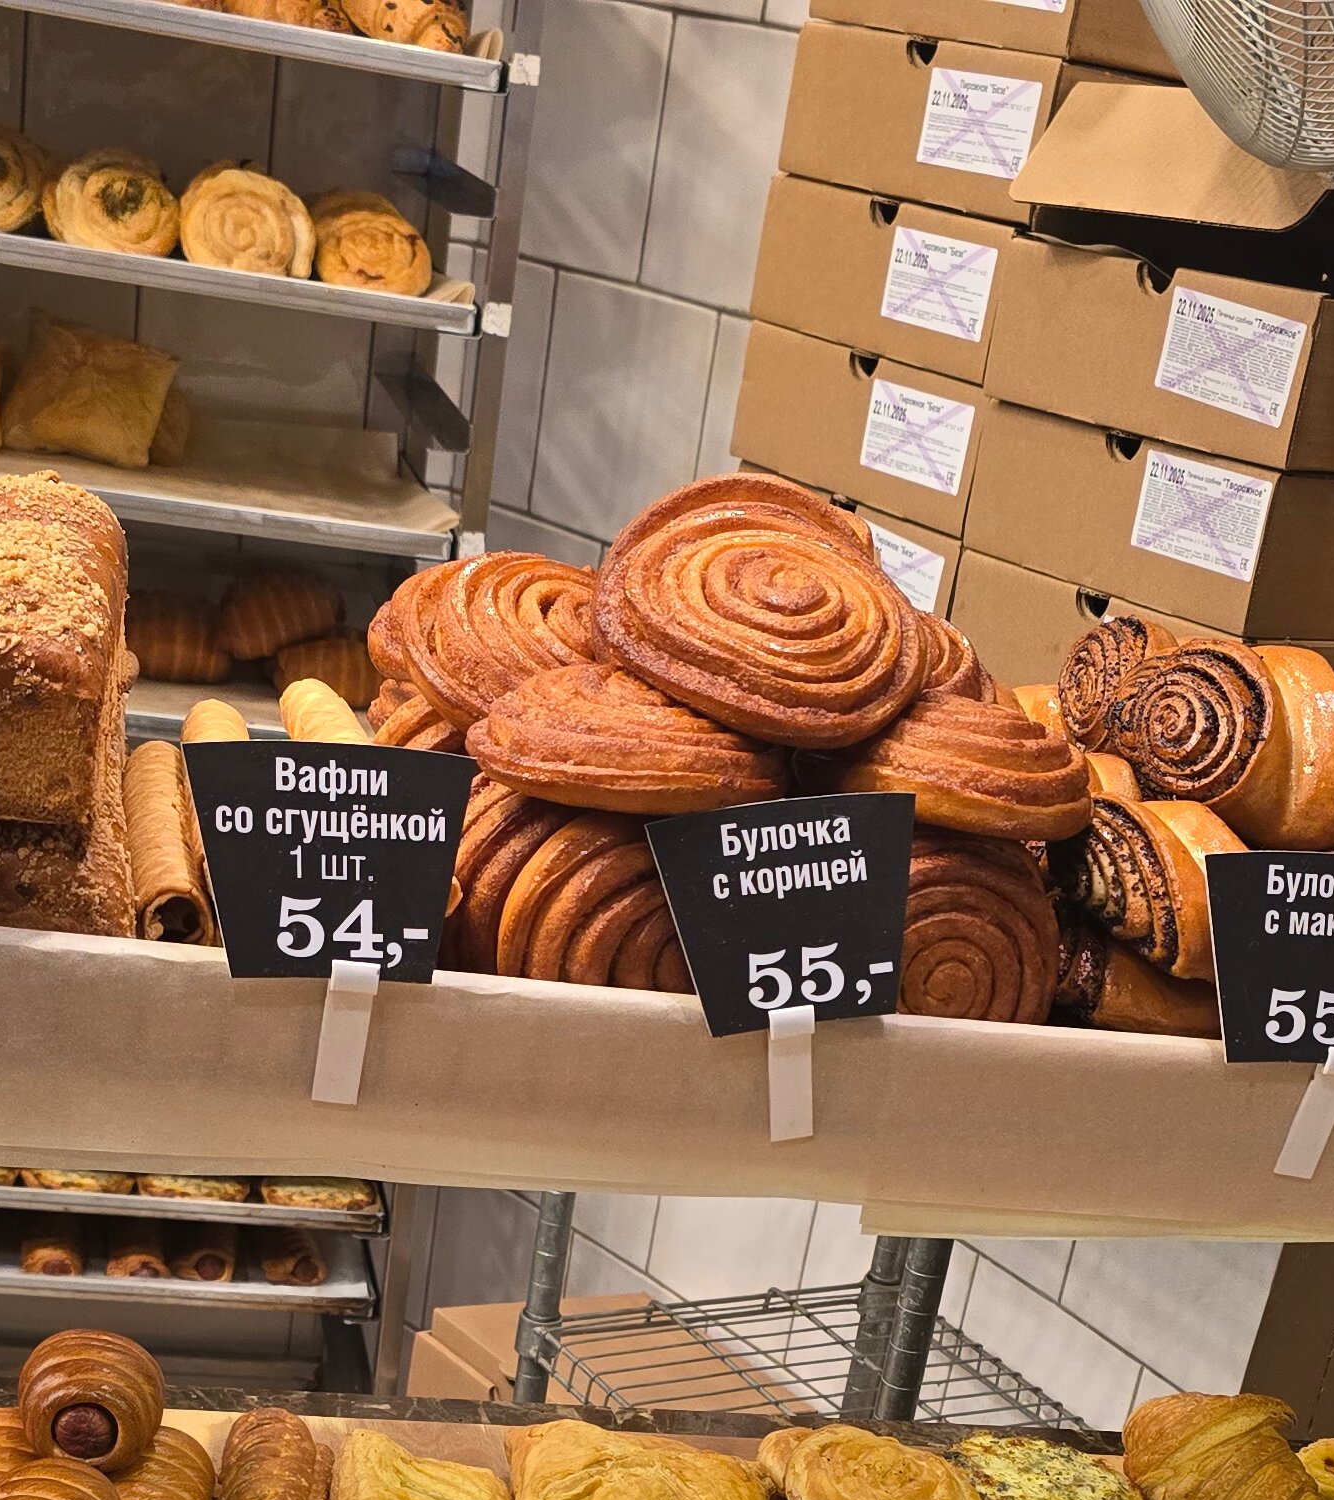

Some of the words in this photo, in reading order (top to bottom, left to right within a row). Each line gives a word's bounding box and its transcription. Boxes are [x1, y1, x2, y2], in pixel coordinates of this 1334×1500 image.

[931, 89, 968, 111] 22.11.2025
[895, 248, 929, 269] 22.11.2025
[1177, 298, 1215, 324] 22.11.2025
[873, 400, 907, 423] 22.11.2025
[1150, 462, 1185, 486] 22.11.2025
[275, 756, 388, 801] Вафли
[215, 805, 253, 833] со
[266, 805, 446, 843] сгущёнкой
[720, 817, 851, 861] Булочка
[290, 845, 302, 878] 1
[321, 854, 374, 881] шт.
[712, 872, 730, 899] с
[739, 850, 868, 899] корицей
[276, 895, 429, 968] 54,-
[1264, 909, 1279, 934] с
[748, 942, 894, 1009] 55,-
